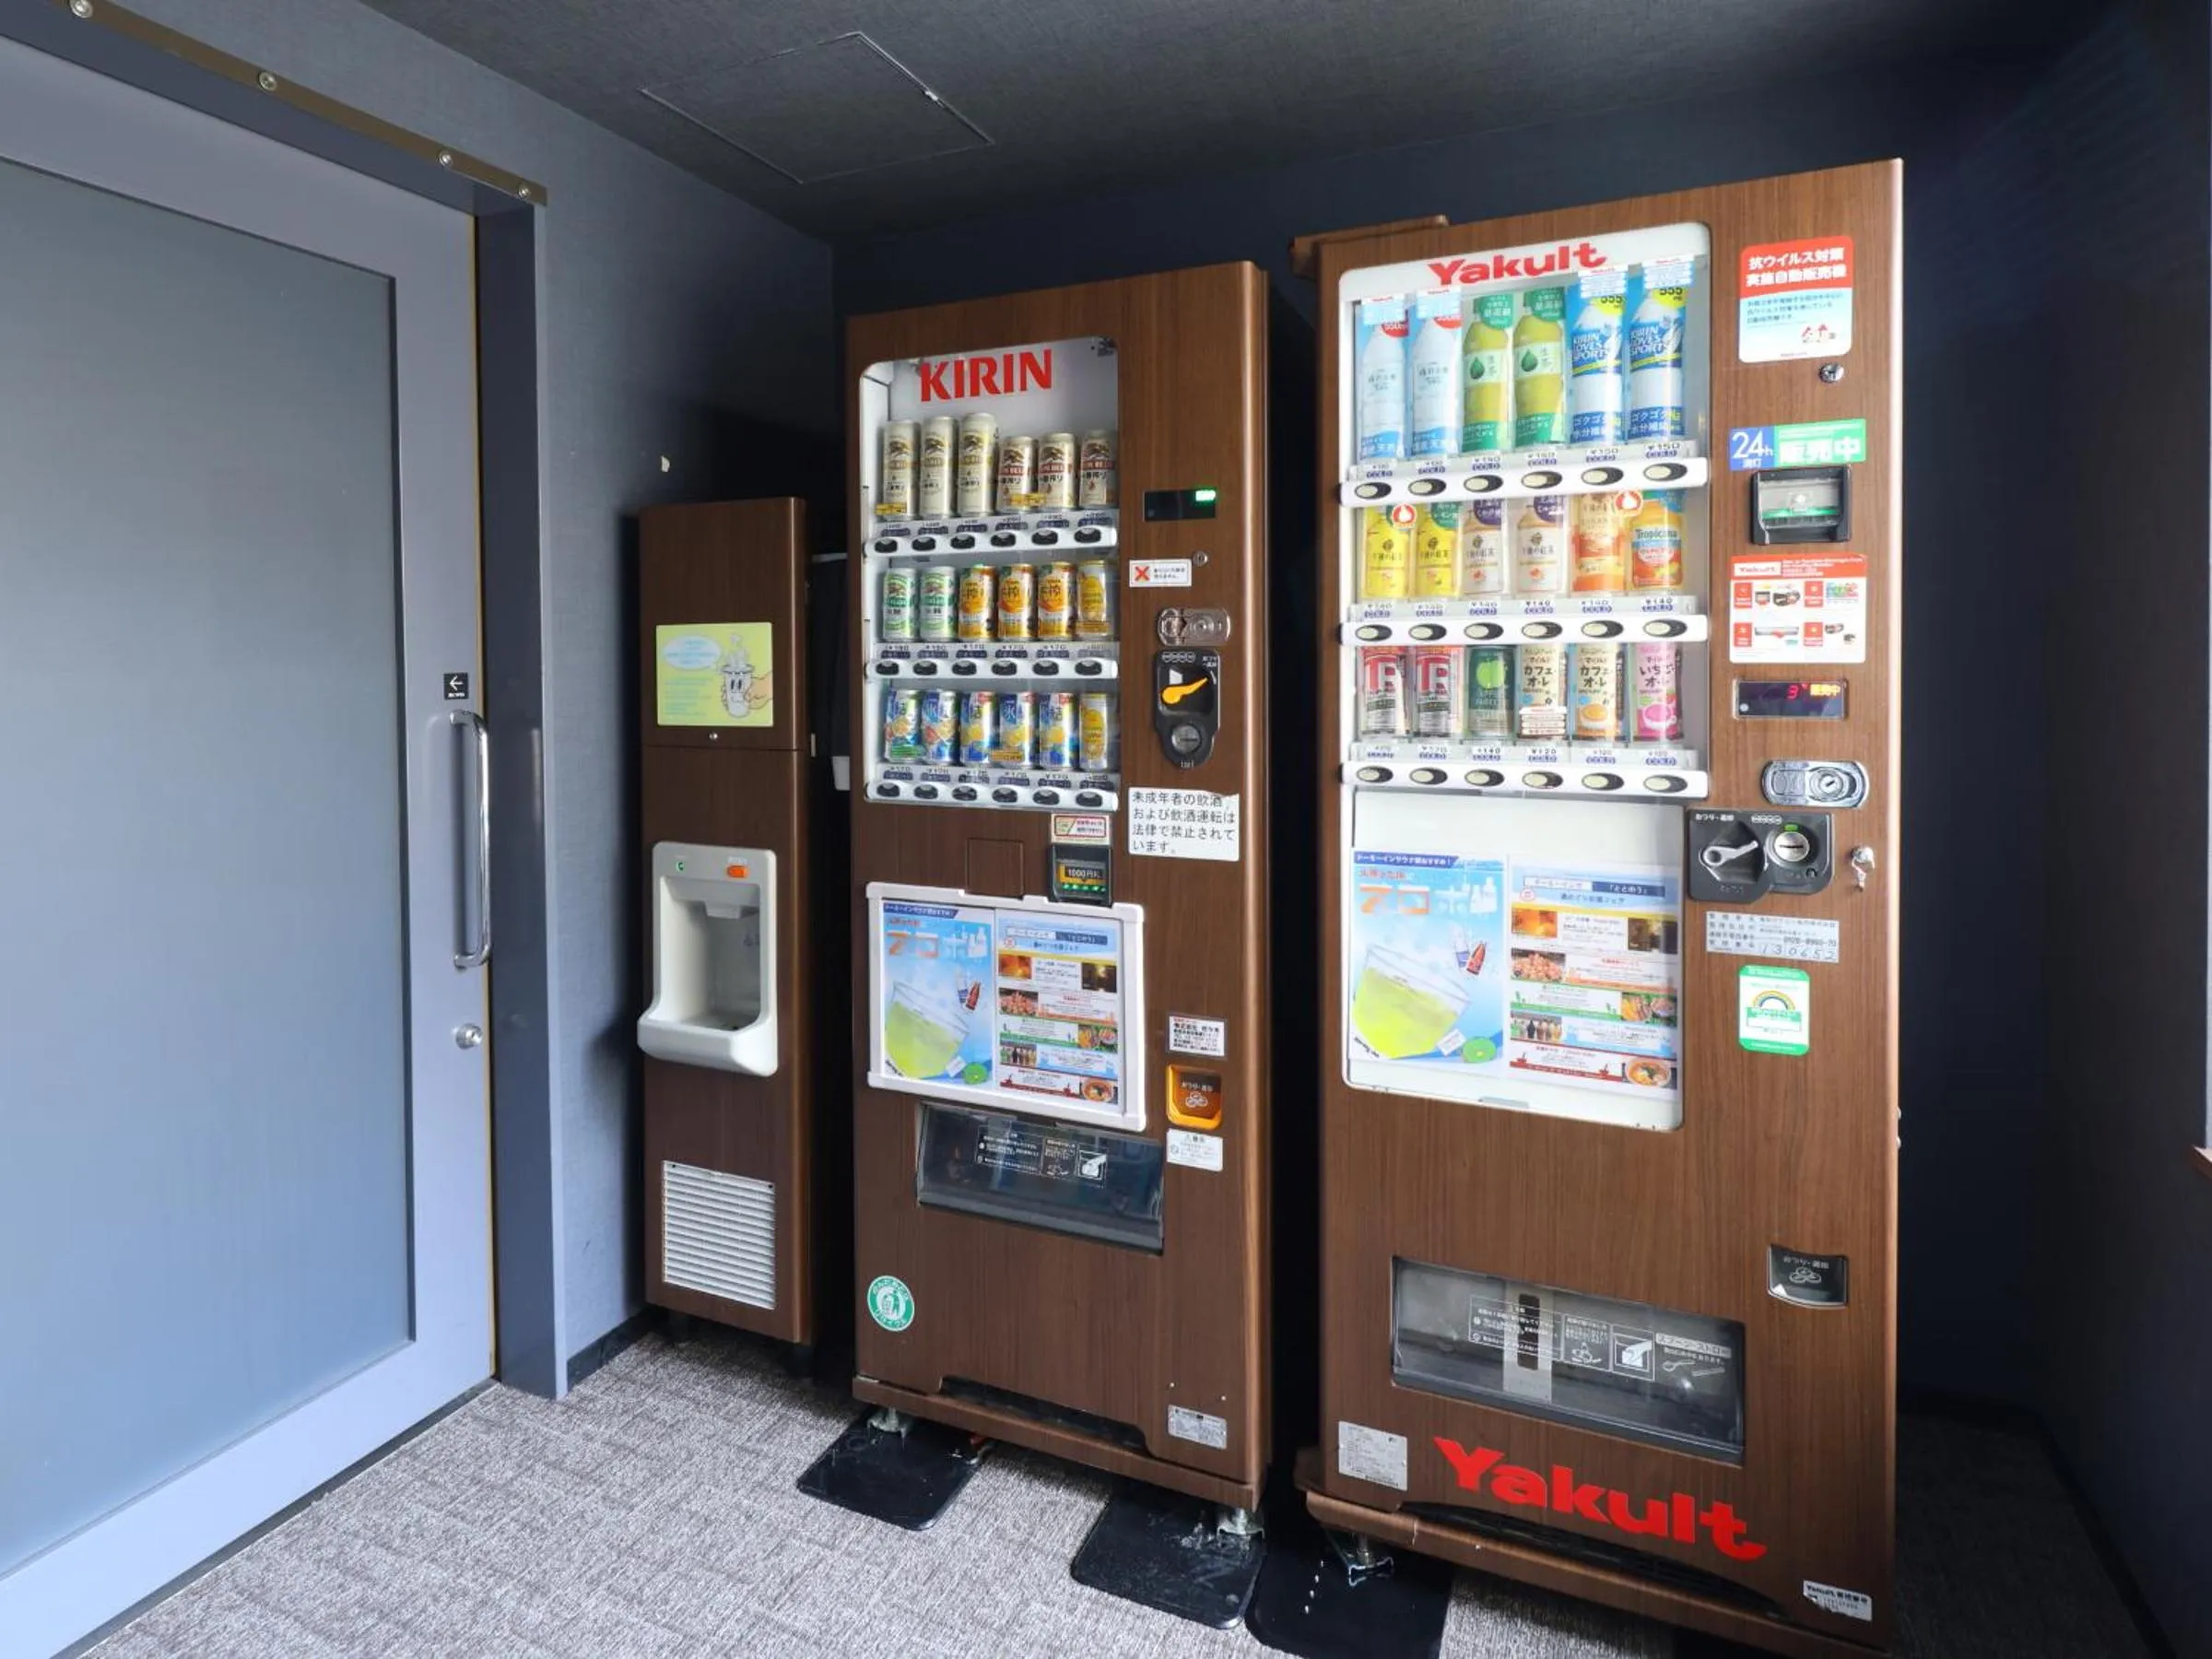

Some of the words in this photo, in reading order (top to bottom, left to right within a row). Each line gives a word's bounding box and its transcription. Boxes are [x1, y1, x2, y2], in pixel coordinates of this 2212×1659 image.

[1427, 242, 1608, 286] Yakult
[920, 349, 1052, 402] KIRIN
[1134, 807, 1236, 824] および飲酒運転は
[1132, 824, 1235, 841] 法律で禁止されて
[1133, 841, 1176, 854] います。
[1433, 1436, 1768, 1560] Yakult
